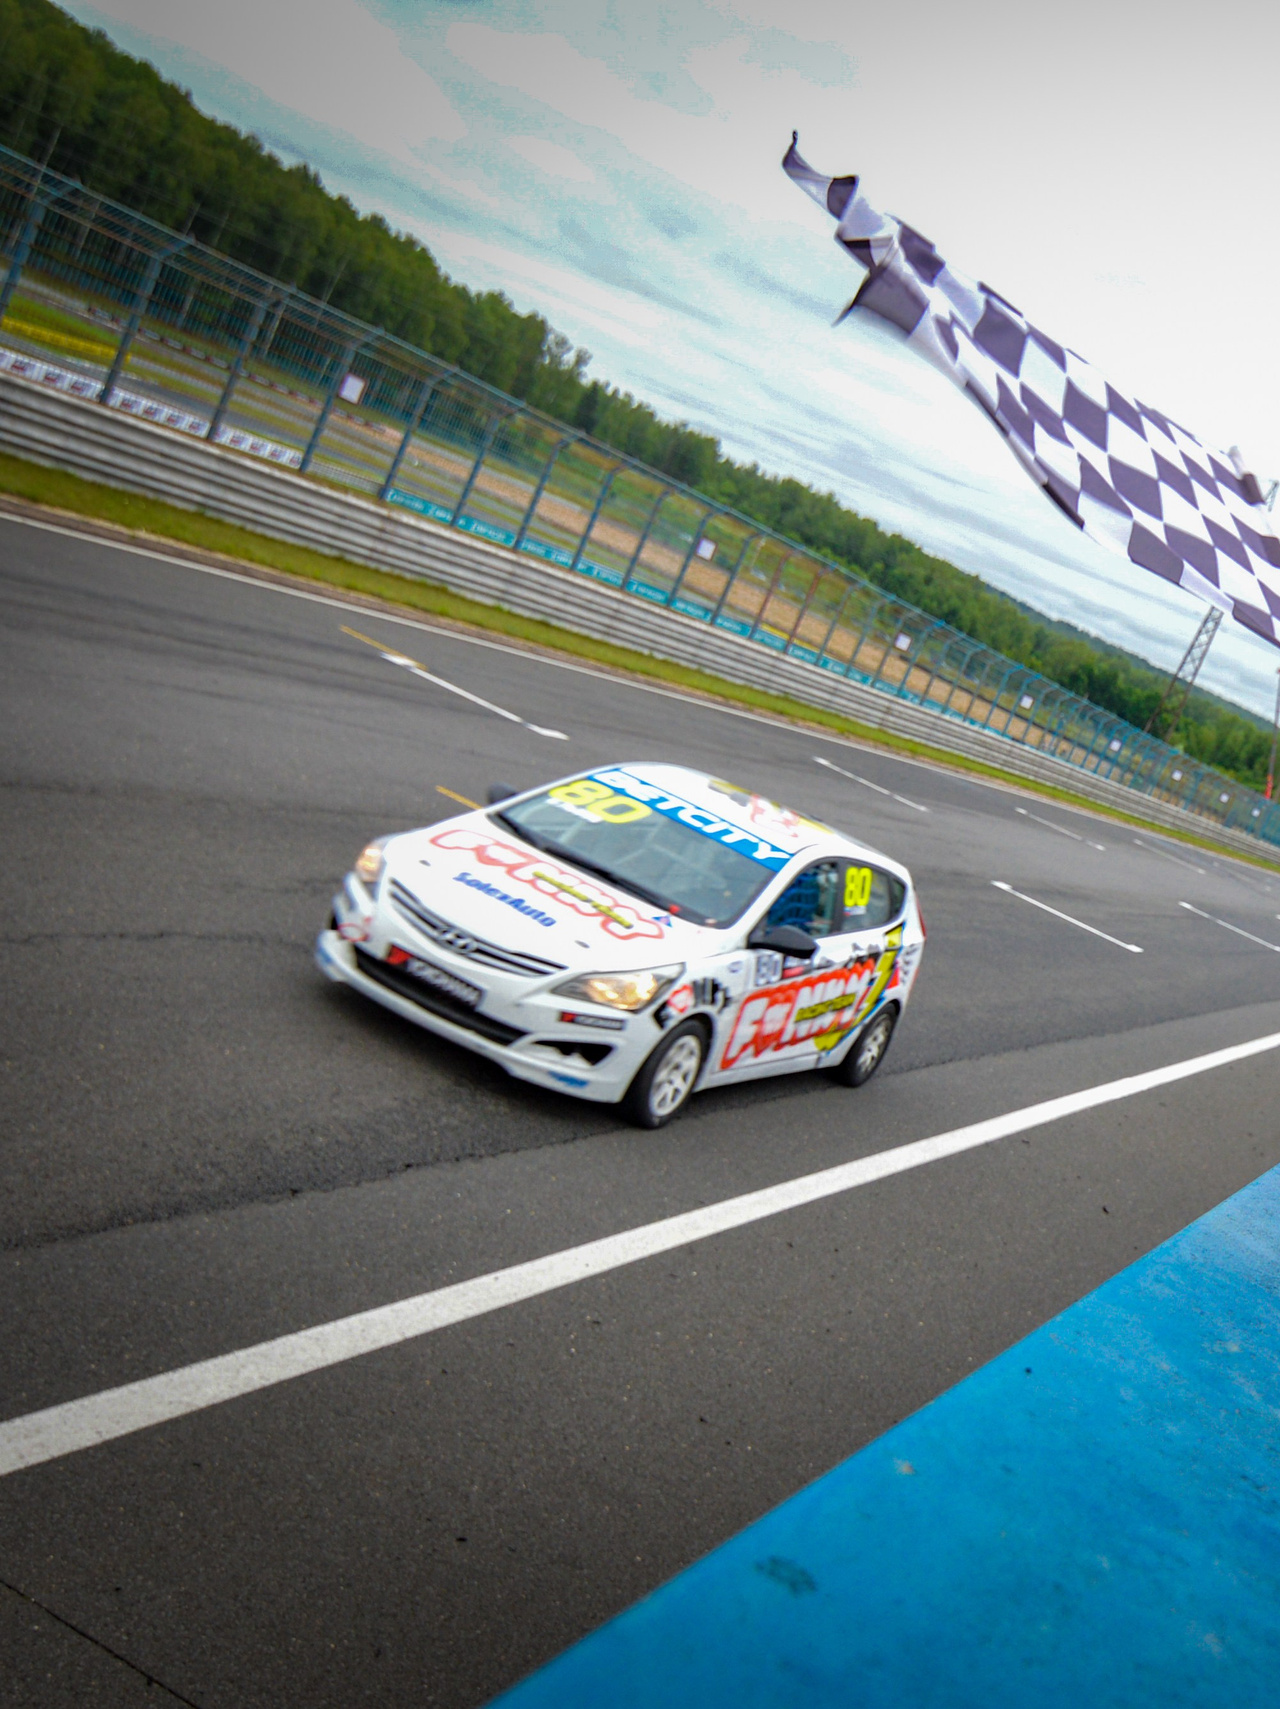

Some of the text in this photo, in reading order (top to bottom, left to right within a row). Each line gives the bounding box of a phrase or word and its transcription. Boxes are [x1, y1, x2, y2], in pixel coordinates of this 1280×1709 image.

[548, 779, 652, 824] 80
[593, 770, 792, 860] BETCITY
[843, 866, 873, 907] 80
